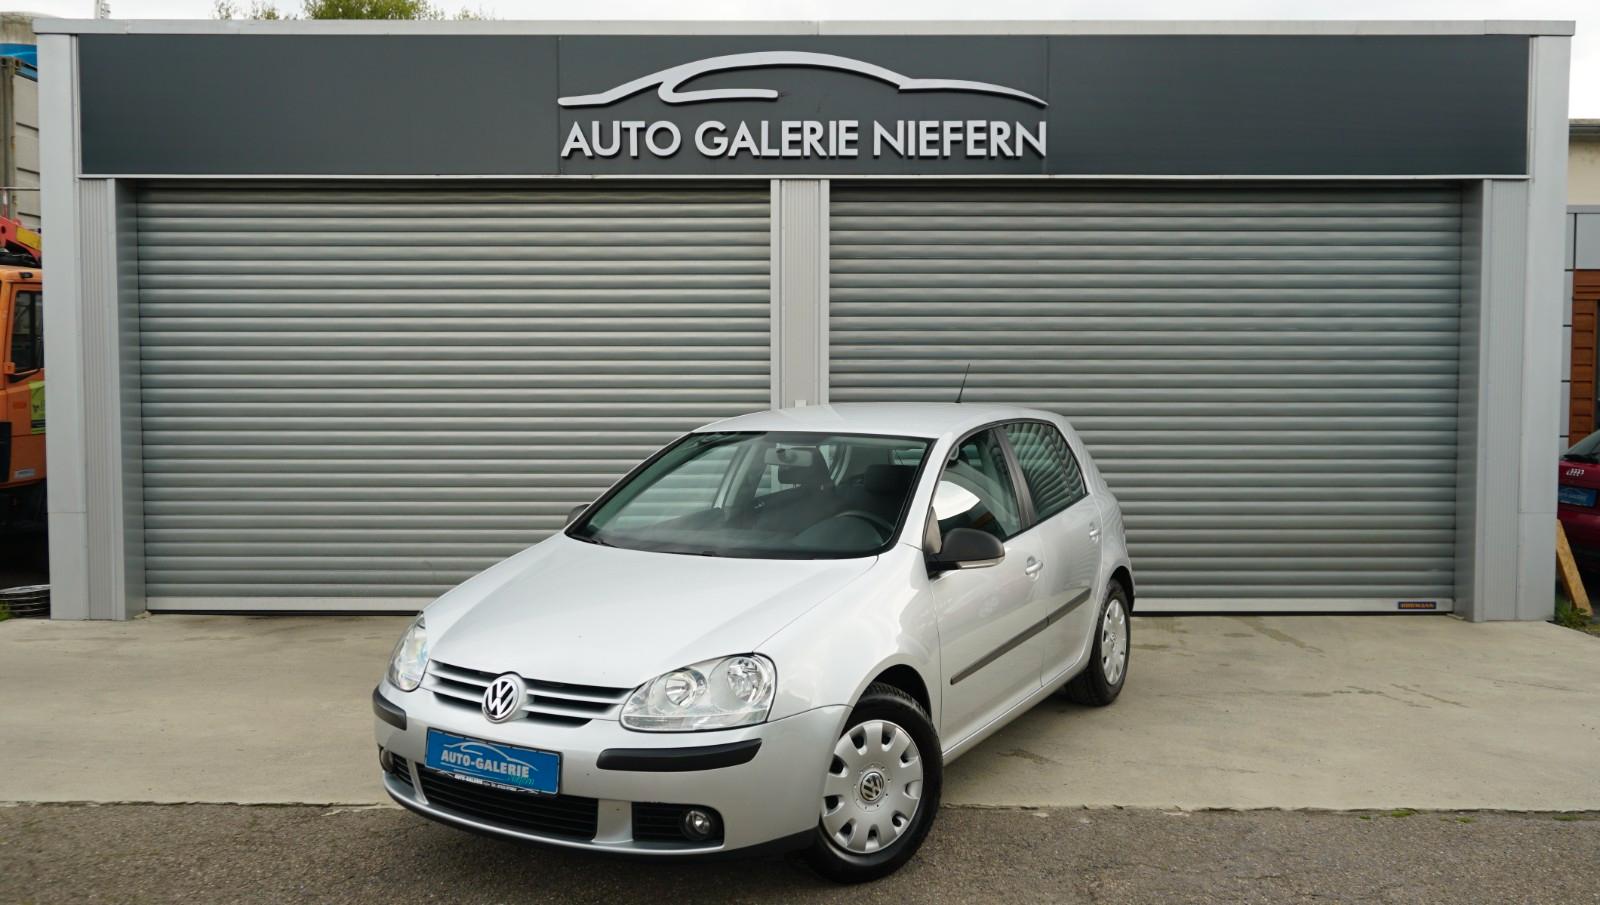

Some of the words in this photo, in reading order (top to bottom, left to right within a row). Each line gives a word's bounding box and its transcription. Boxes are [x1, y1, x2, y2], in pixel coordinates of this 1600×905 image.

[561, 120, 682, 159] AUTO
[694, 119, 859, 159] GALERIE
[873, 119, 1048, 159] NIEFERN
[441, 749, 529, 778] AUTO-GALERIE
